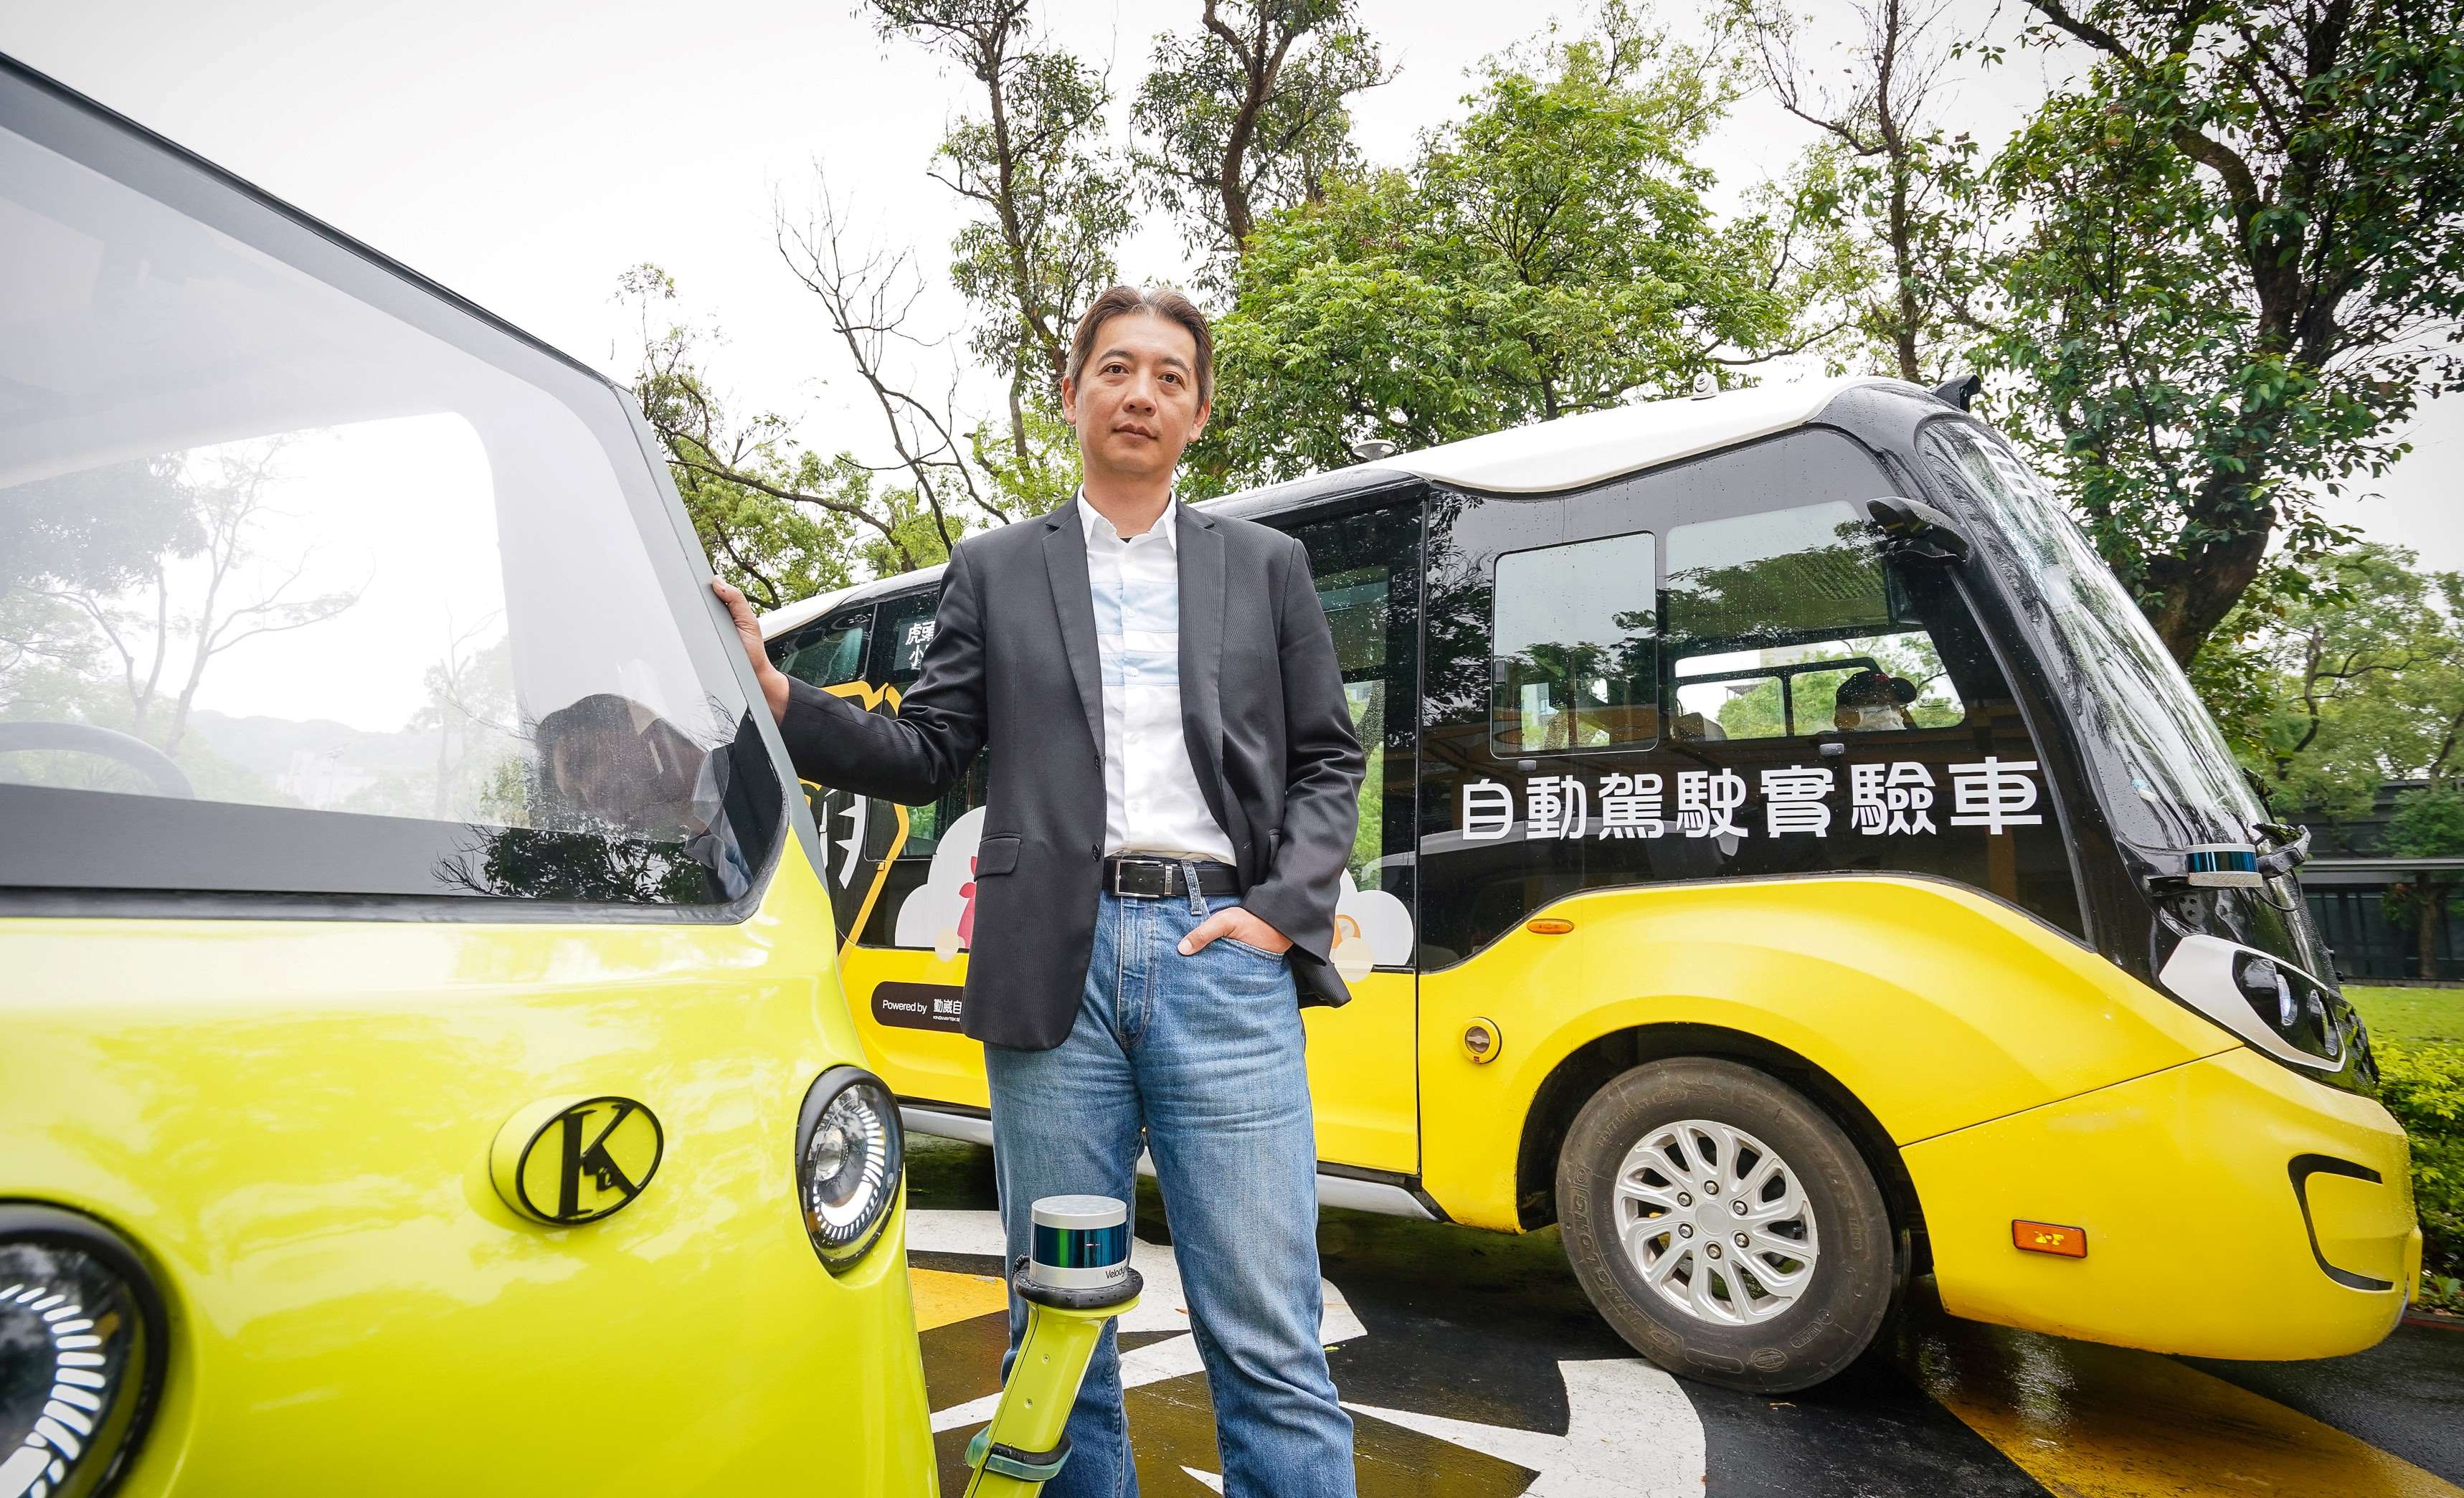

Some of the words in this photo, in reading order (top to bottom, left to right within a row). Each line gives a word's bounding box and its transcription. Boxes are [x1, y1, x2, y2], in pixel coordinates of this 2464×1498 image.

[1461, 756, 2043, 840] 自動駕駛實驗車
[882, 999, 916, 1012] Powered
[917, 1002, 927, 1015] by
[1105, 1265, 1127, 1279] Velody
